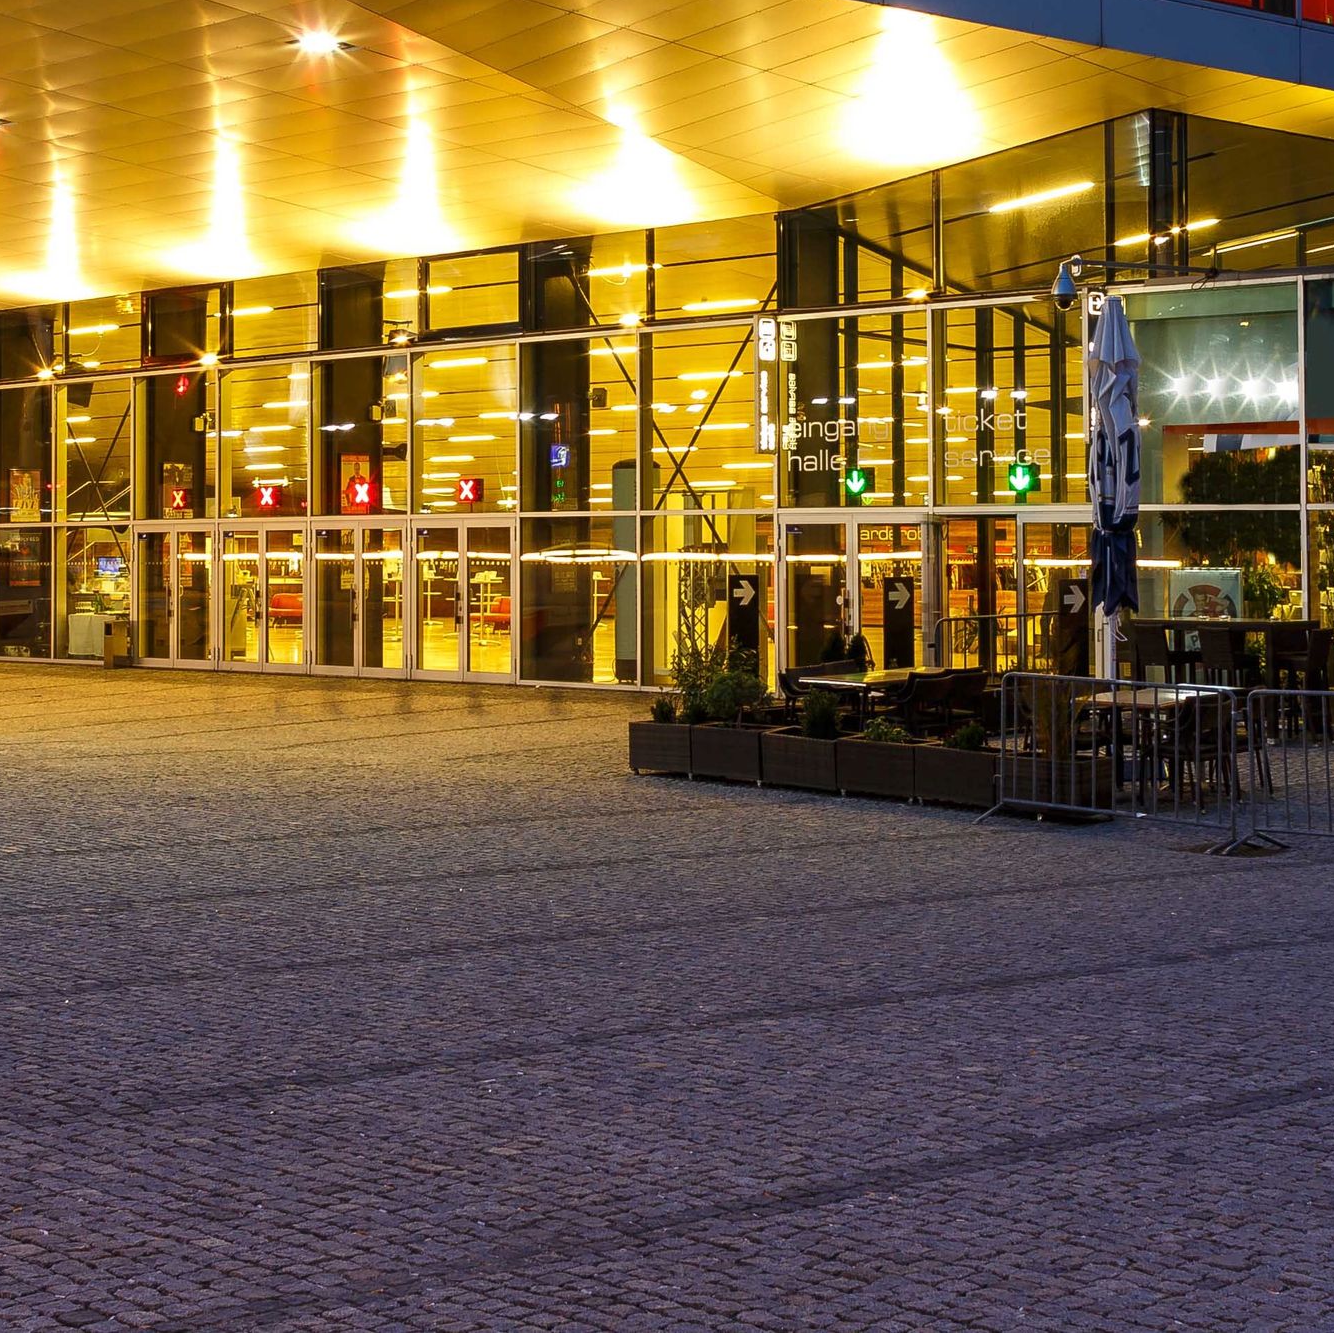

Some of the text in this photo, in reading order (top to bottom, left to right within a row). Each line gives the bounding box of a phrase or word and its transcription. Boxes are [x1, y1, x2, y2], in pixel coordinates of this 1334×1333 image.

[943, 408, 1028, 432] ticket
[787, 449, 844, 472] halle
[944, 443, 1051, 468] service
